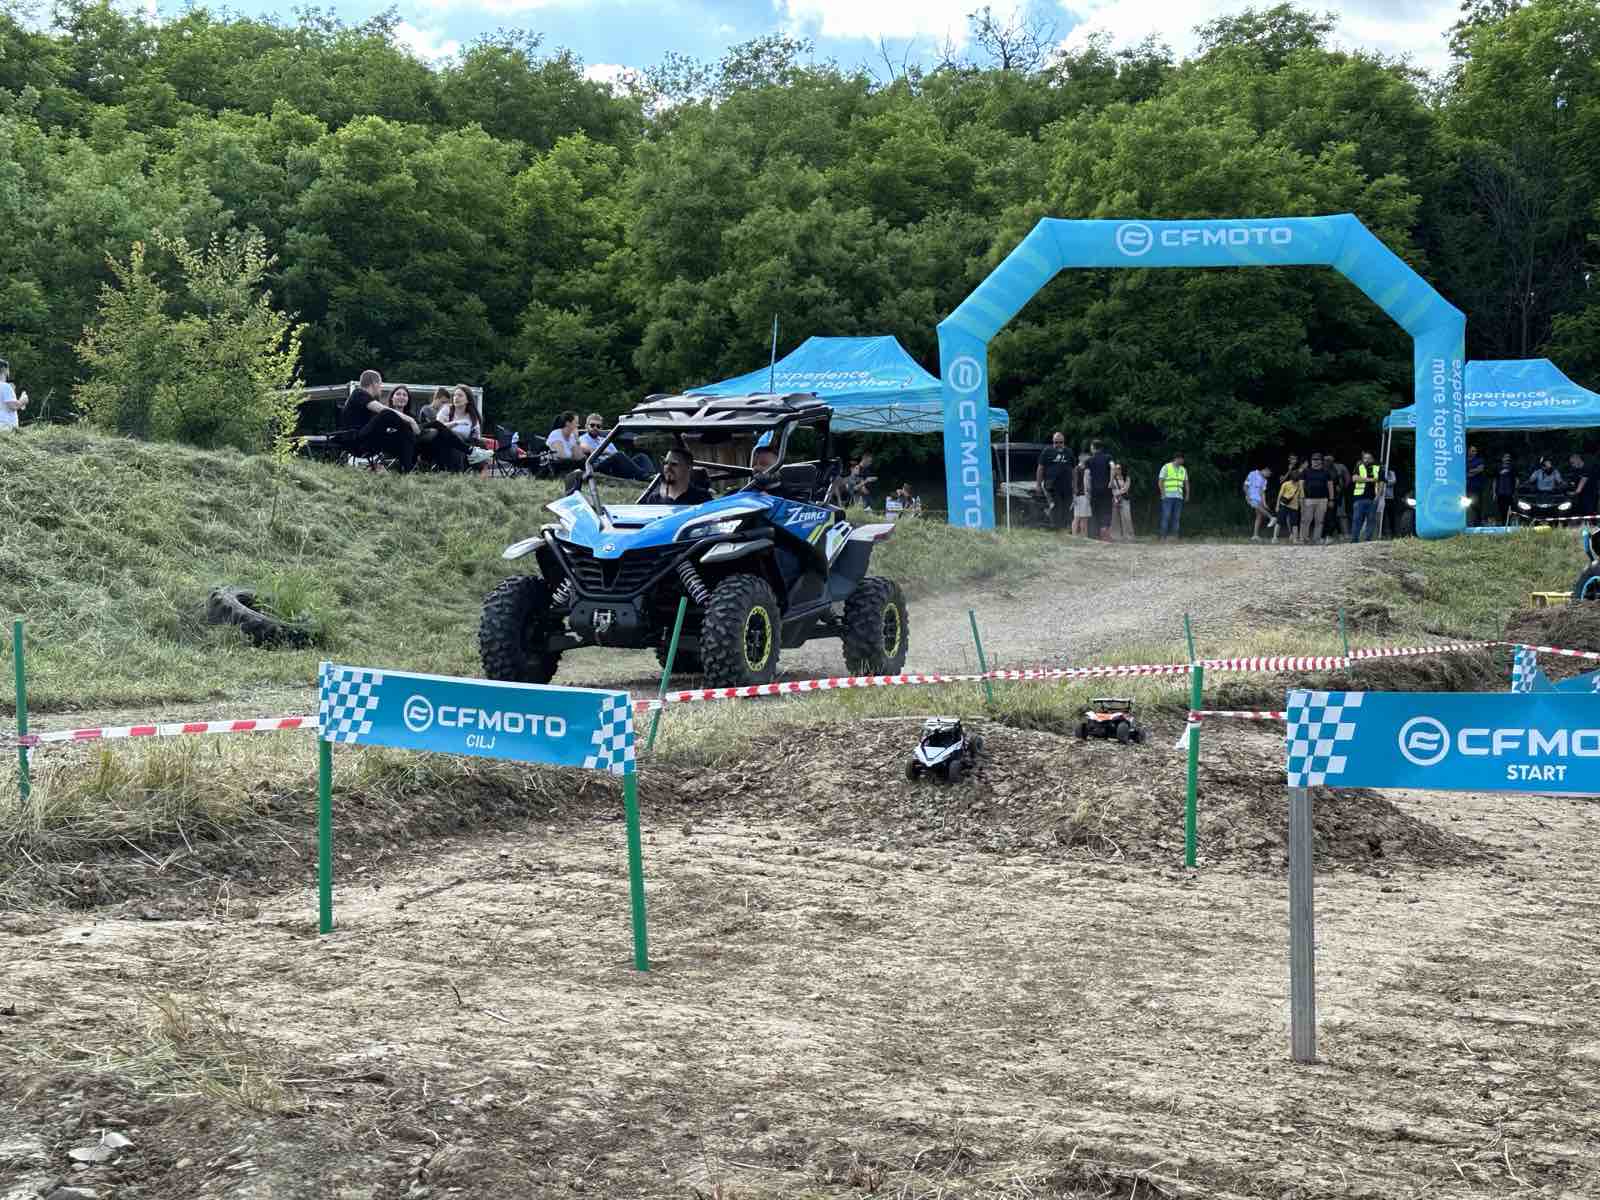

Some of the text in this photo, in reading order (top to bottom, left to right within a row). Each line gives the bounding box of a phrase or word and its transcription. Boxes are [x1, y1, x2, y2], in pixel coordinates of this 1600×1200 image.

[1160, 226, 1293, 247] CFMOTO
[815, 376, 898, 392] together
[1464, 389, 1547, 401] xperience
[1503, 397, 1577, 409] together
[1447, 358, 1465, 455] experience
[1428, 358, 1453, 487] more together
[959, 400, 982, 529] CFMOTO
[437, 705, 567, 738] CFMOTO
[466, 733, 497, 750] CILJ
[1506, 764, 1568, 781] START
